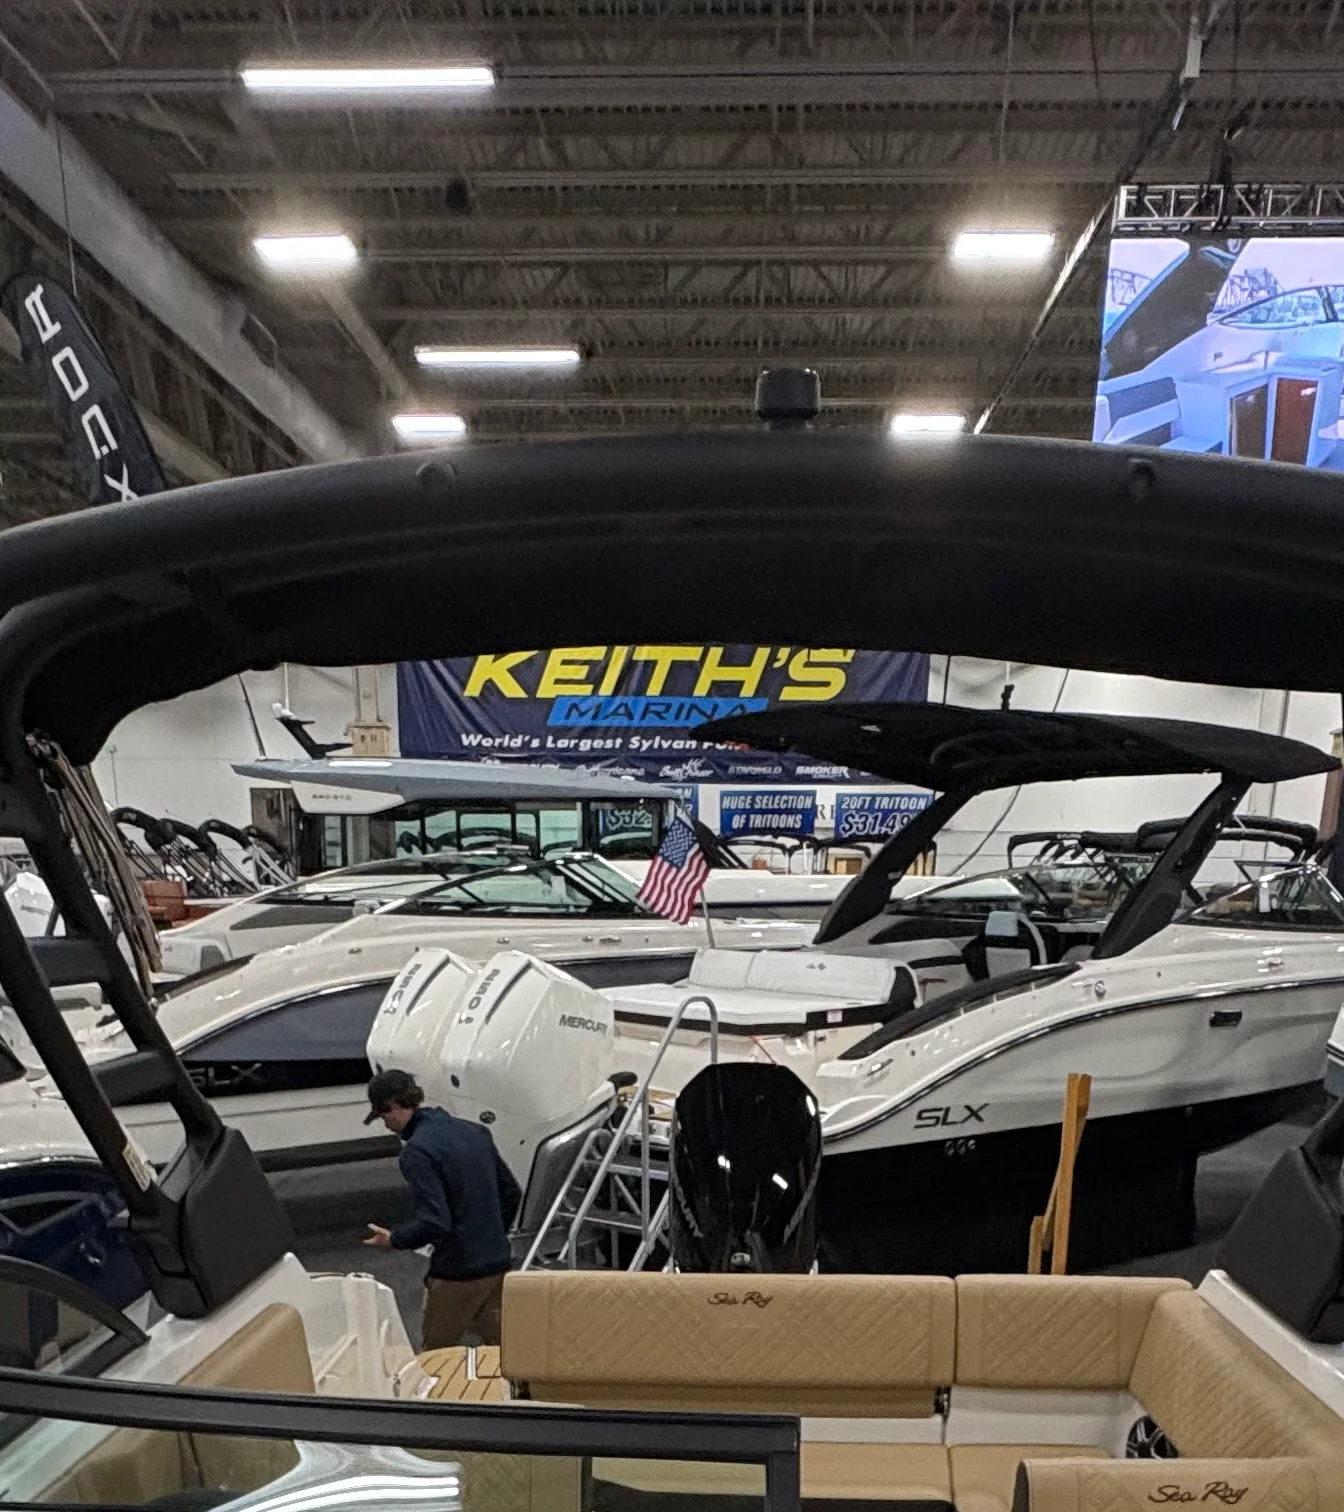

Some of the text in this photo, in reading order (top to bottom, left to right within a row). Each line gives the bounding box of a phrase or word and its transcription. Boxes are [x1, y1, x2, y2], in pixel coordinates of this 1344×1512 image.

[463, 645, 856, 700] KEITH'S
[460, 733, 541, 748] World's
[545, 735, 623, 752] Largest
[628, 734, 698, 752] Sylvan
[796, 766, 851, 779] SMOKER
[721, 794, 814, 809] HUGE SELECTION
[840, 796, 928, 810] 20FT TRITOON
[731, 814, 803, 829] OF TRITOONS
[913, 1102, 991, 1130] SLX
[707, 1290, 774, 1309] Sea Ray
[1147, 1480, 1250, 1505] Sea Ray
